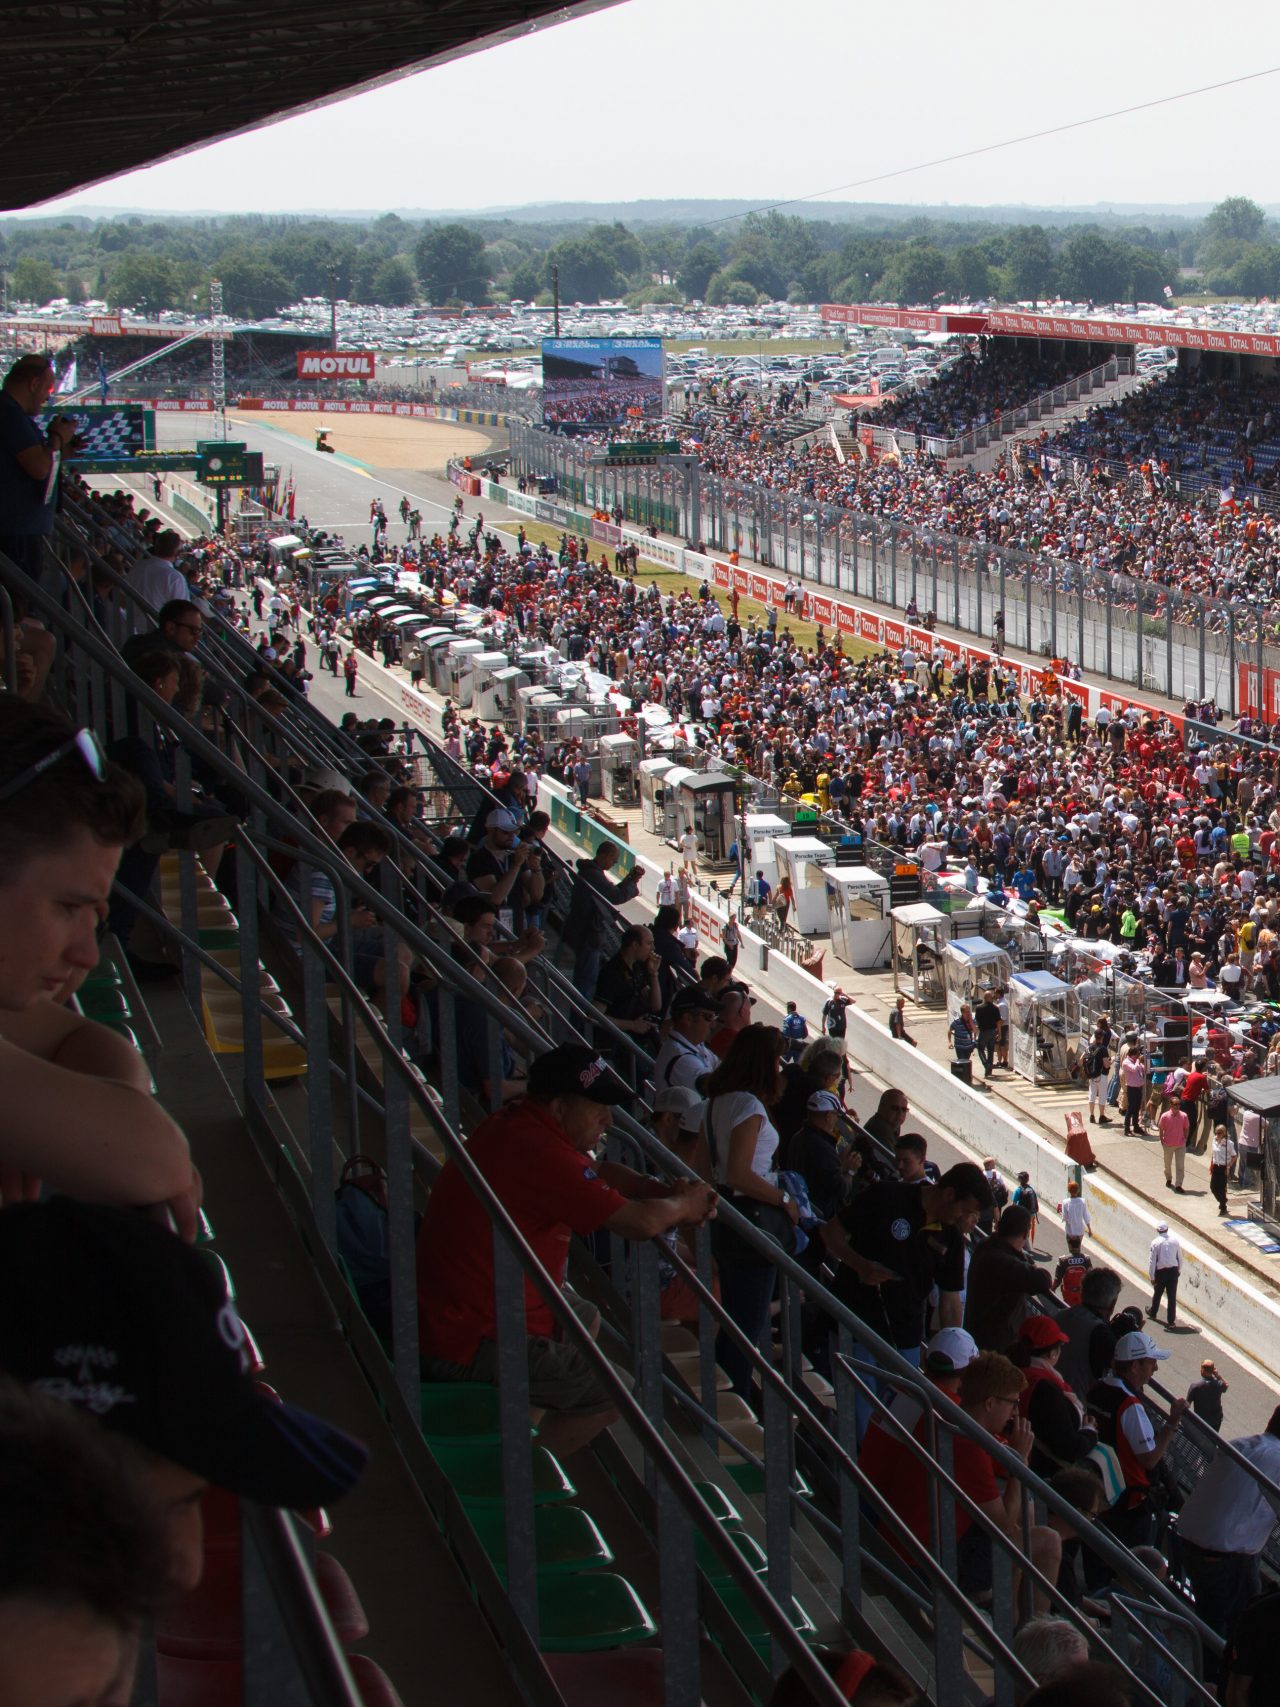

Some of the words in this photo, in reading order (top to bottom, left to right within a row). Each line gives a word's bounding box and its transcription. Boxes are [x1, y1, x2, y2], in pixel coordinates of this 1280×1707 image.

[93, 319, 121, 334] MOTUL
[1005, 315, 1018, 328] TOTAL
[1021, 317, 1035, 331] TOTAL
[1036, 319, 1051, 331] TOTAL
[1053, 321, 1068, 333] TOTAL
[1070, 322, 1086, 335] TOTAL
[1088, 323, 1104, 336] TOTAL
[1106, 325, 1123, 338] TOTAL
[1125, 326, 1143, 339] TOTAL
[1145, 328, 1163, 341] TOTAL
[1165, 330, 1183, 344] TOTAL
[1185, 331, 1204, 345] TOTAL
[1207, 333, 1226, 348] TOTAL
[1229, 335, 1249, 350] TOTAL
[1252, 337, 1272, 352] TOTAL
[302, 357, 371, 374] MOTUL
[156, 401, 180, 410] MOTUL
[184, 401, 208, 410] MOTUL
[263, 401, 289, 410] MOTUL
[294, 401, 319, 411] MOTUL
[324, 402, 346, 412] MOTUL
[350, 403, 371, 413] MOTUL
[373, 404, 393, 414] MOTUL
[716, 566, 729, 583] TOTAL
[733, 572, 747, 589] TOTAL
[753, 577, 767, 596] TOTAL
[815, 600, 830, 619] TOTAL
[838, 608, 854, 627] TOTAL
[862, 616, 877, 635] TOTAL
[886, 624, 903, 644] TOTAL
[401, 689, 432, 723] PORSCHE
[902, 866, 911, 874] 17
